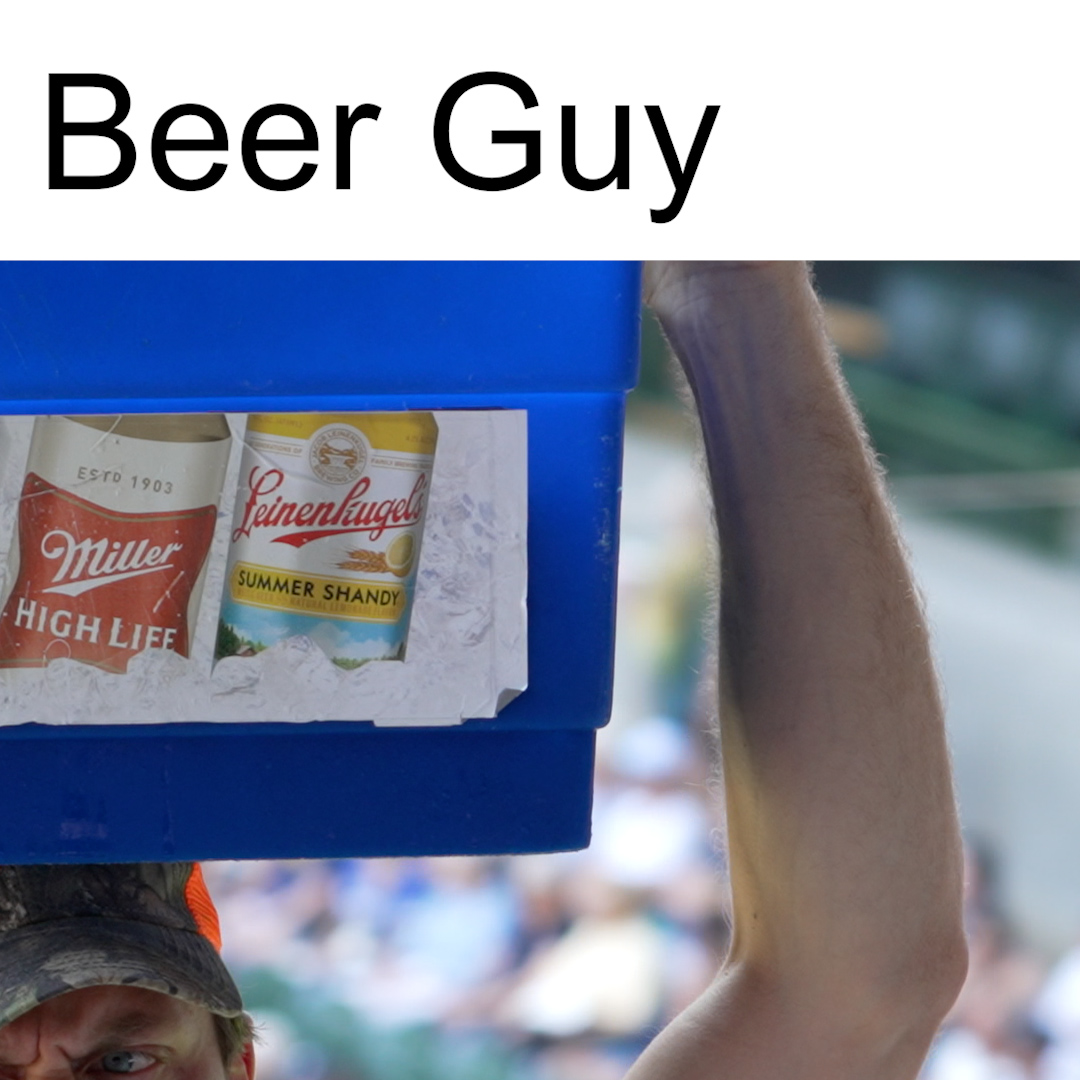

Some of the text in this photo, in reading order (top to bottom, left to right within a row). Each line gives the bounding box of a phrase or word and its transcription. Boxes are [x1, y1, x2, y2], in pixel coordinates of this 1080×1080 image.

[131, 476, 174, 495] 1903
[41, 530, 183, 586] Miller
[237, 569, 315, 598] SUMMER
[322, 584, 401, 606] SHANDY
[14, 597, 178, 651] HIGH LIFE
